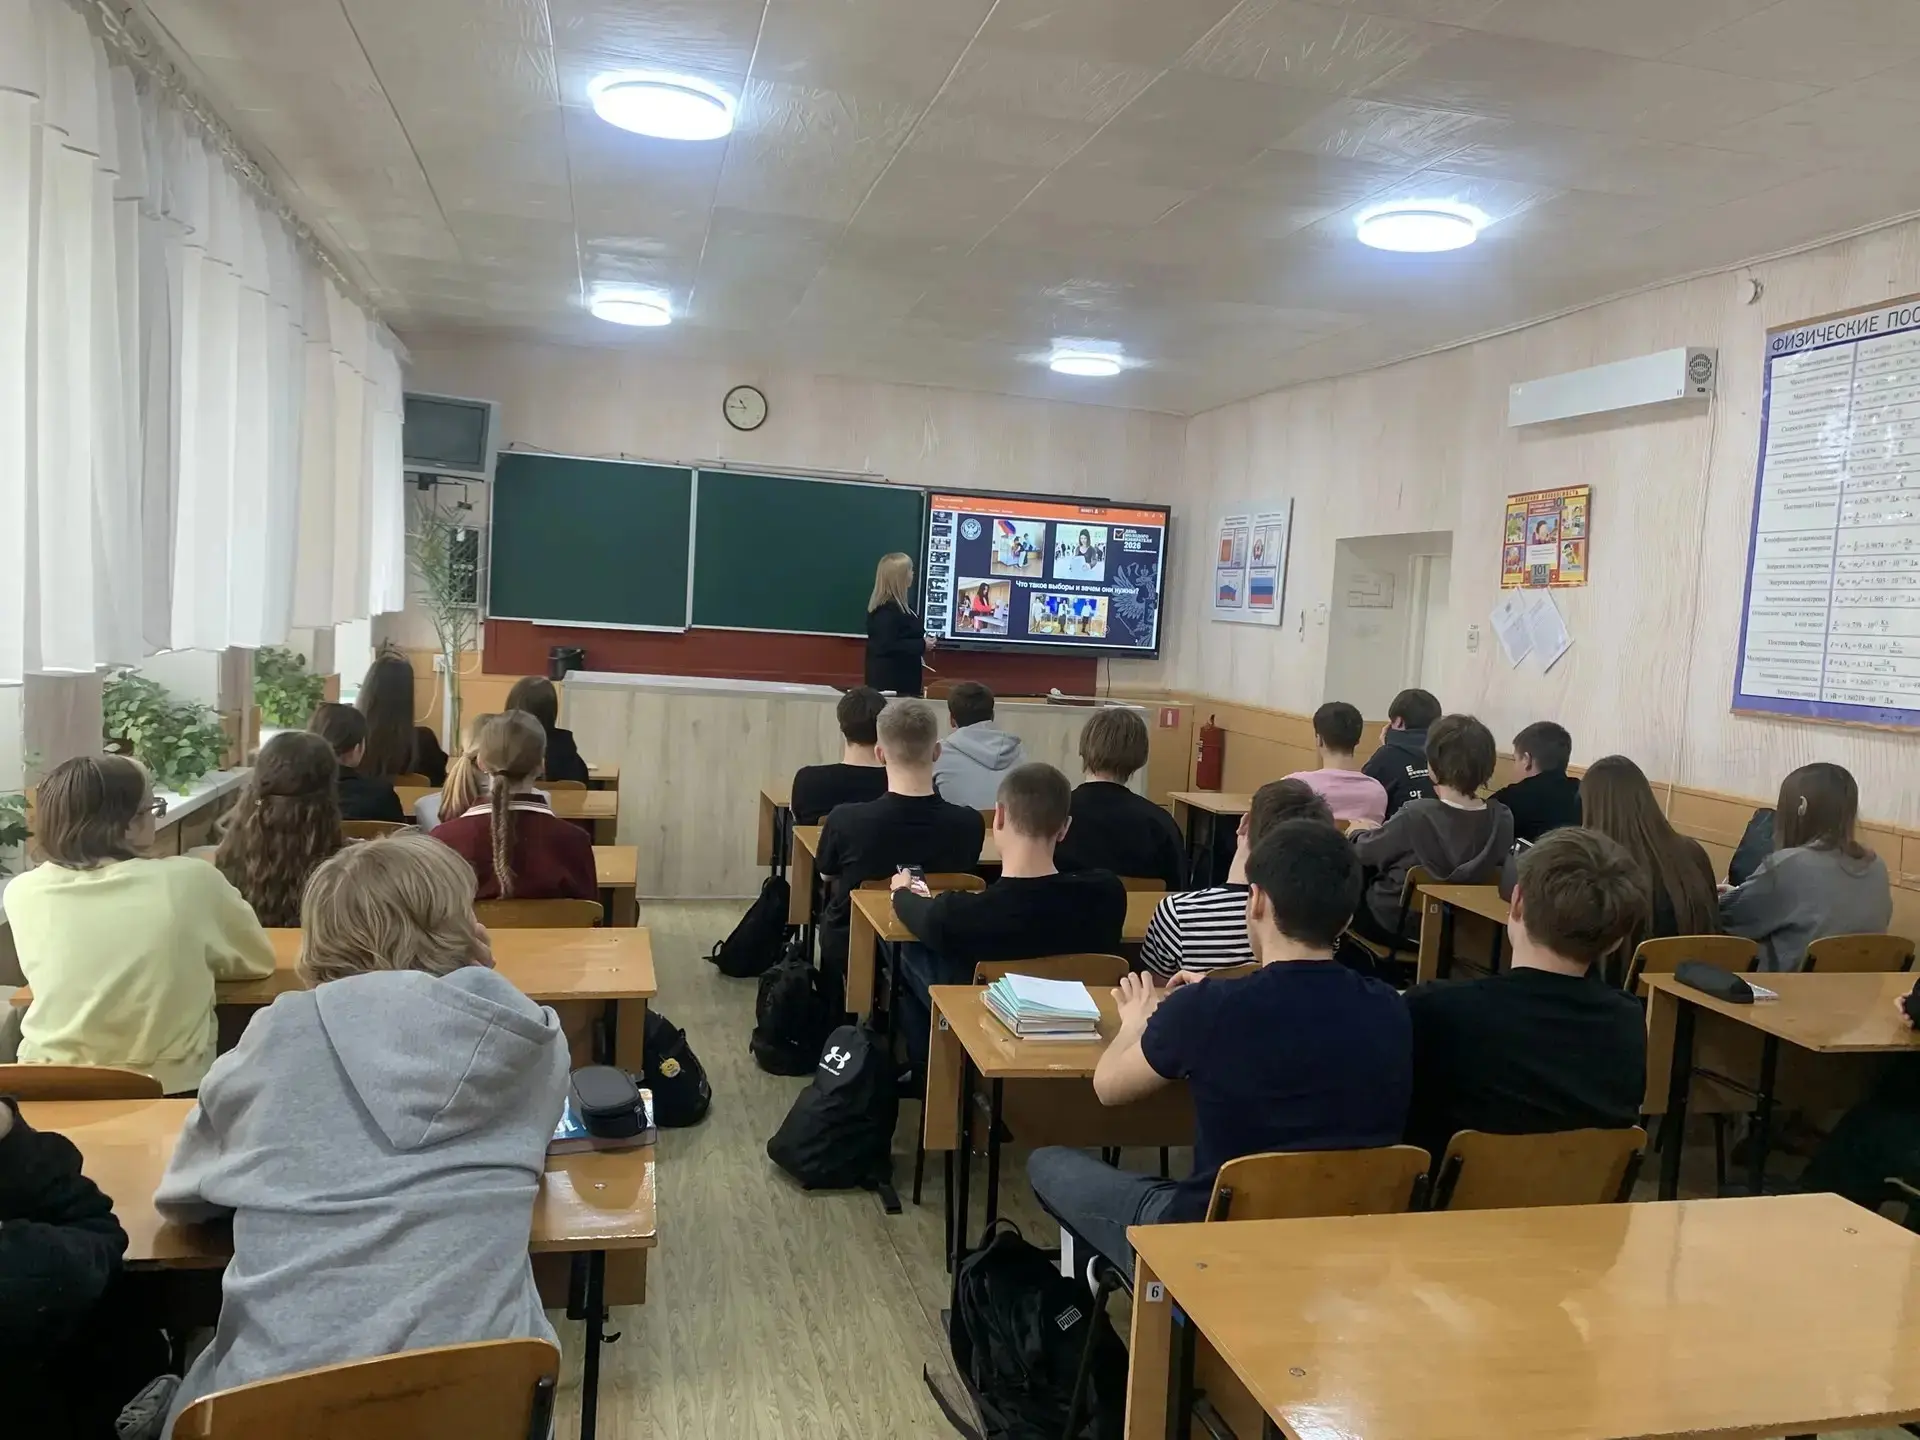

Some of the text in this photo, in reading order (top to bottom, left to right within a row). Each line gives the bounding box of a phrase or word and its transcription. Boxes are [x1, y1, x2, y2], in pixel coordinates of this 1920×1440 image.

[1772, 315, 1879, 352] ФИЗИЧЕСКИЕ
[1124, 541, 1141, 549] 2026
[1015, 580, 1028, 588] Что
[1048, 583, 1074, 591] выборы
[1151, 1285, 1160, 1298] 6
